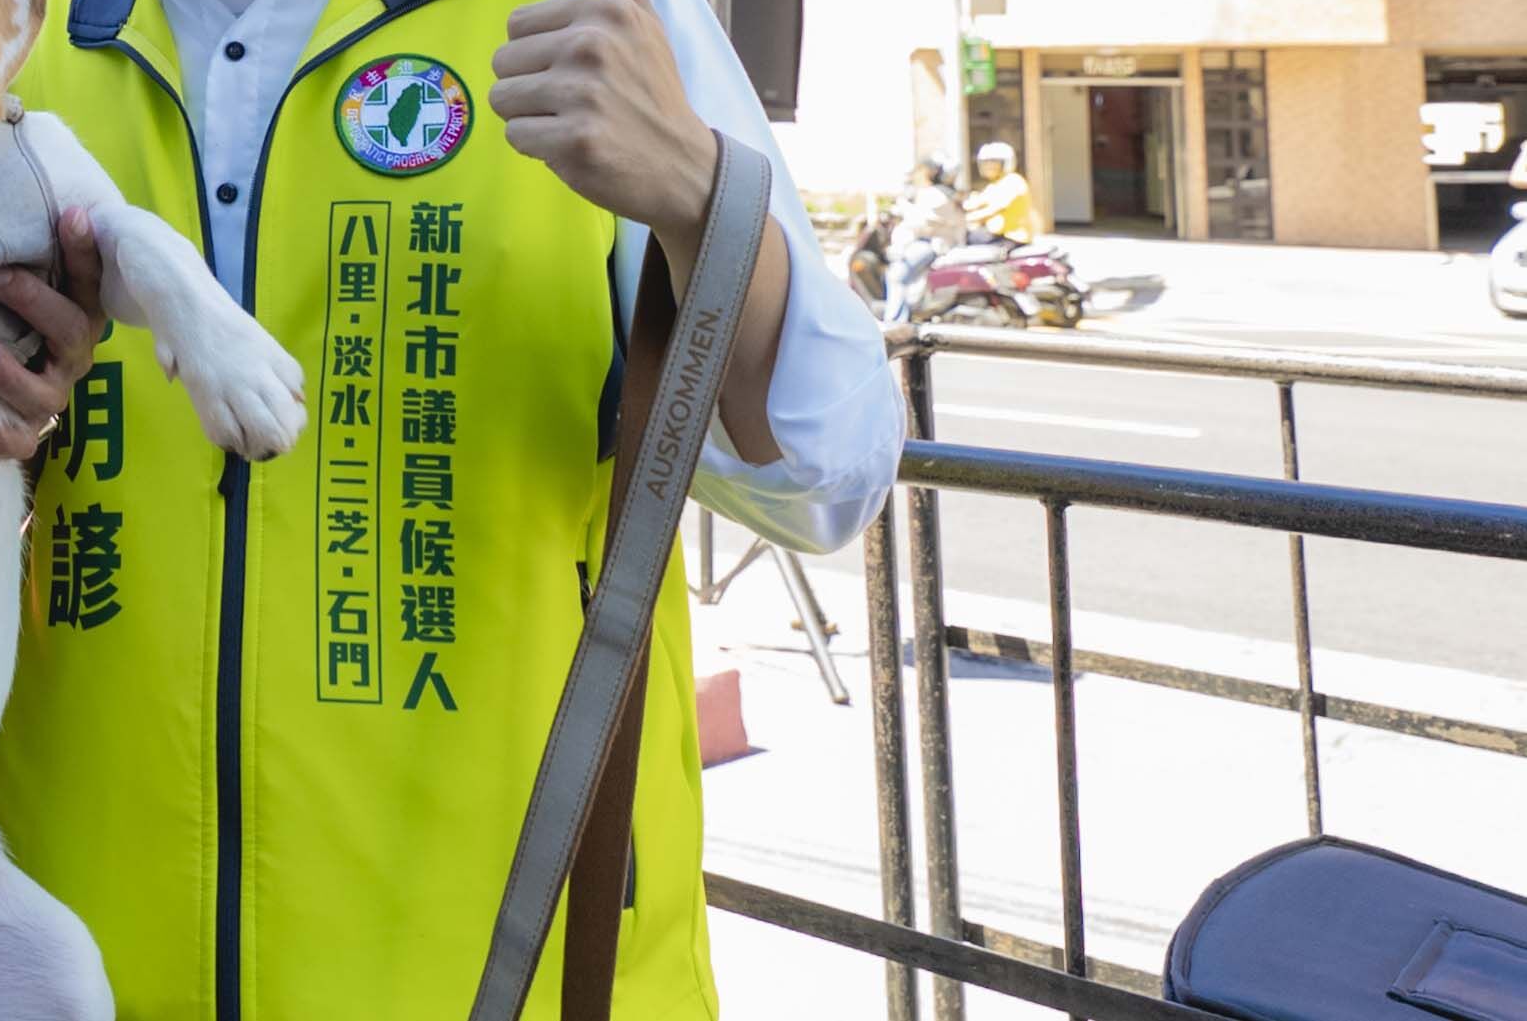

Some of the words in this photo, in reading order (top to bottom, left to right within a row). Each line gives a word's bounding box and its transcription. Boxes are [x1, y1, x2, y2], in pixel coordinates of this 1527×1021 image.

[400, 201, 464, 711] 新北市議員候選人
